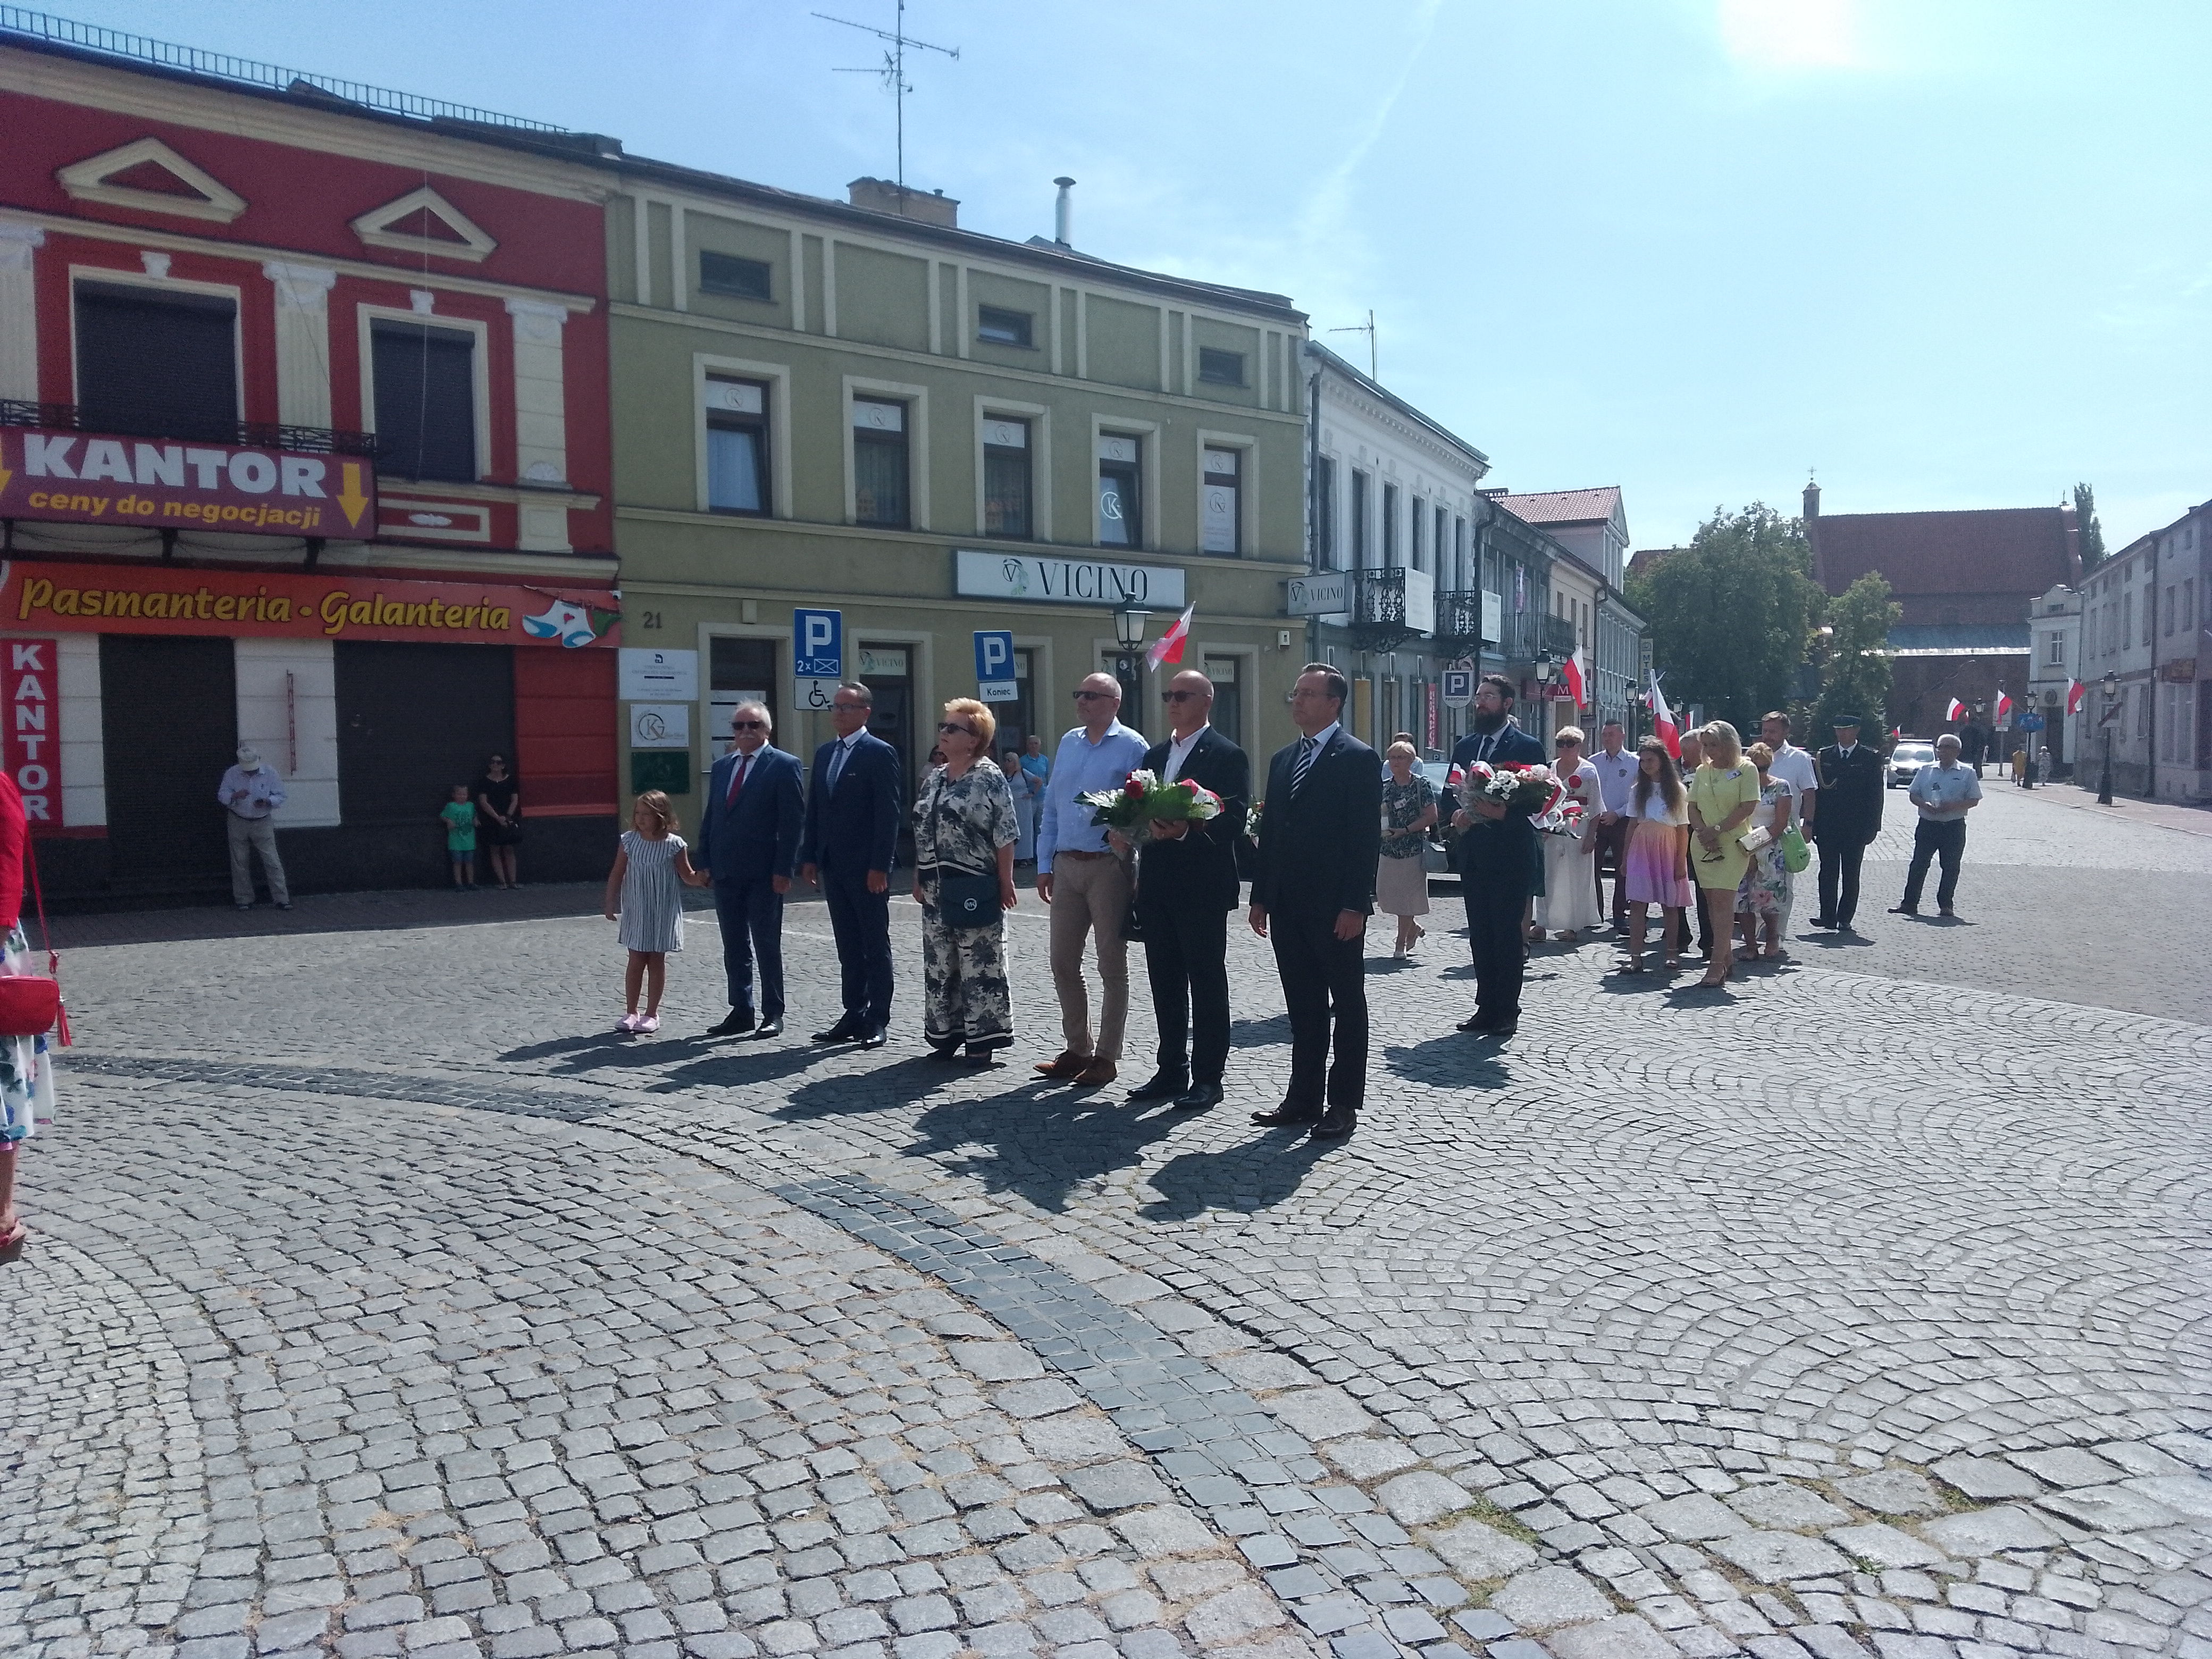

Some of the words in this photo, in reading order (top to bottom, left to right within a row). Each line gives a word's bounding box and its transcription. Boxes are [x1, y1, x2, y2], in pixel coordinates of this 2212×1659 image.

[23, 433, 327, 498] KANTOR
[29, 492, 109, 516] ceny
[116, 495, 155, 515] do
[163, 499, 321, 530] negocjacji
[1037, 562, 1147, 601] VICINO
[1311, 586, 1343, 601] VICINO
[19, 577, 292, 623] Pasmanteria
[320, 591, 510, 634] Galanteria
[643, 611, 662, 629] 21
[806, 616, 832, 657] P
[983, 637, 1006, 675] P
[987, 687, 1011, 696] Koniec
[1451, 675, 1464, 693] P
[12, 644, 51, 821] KANTOR
